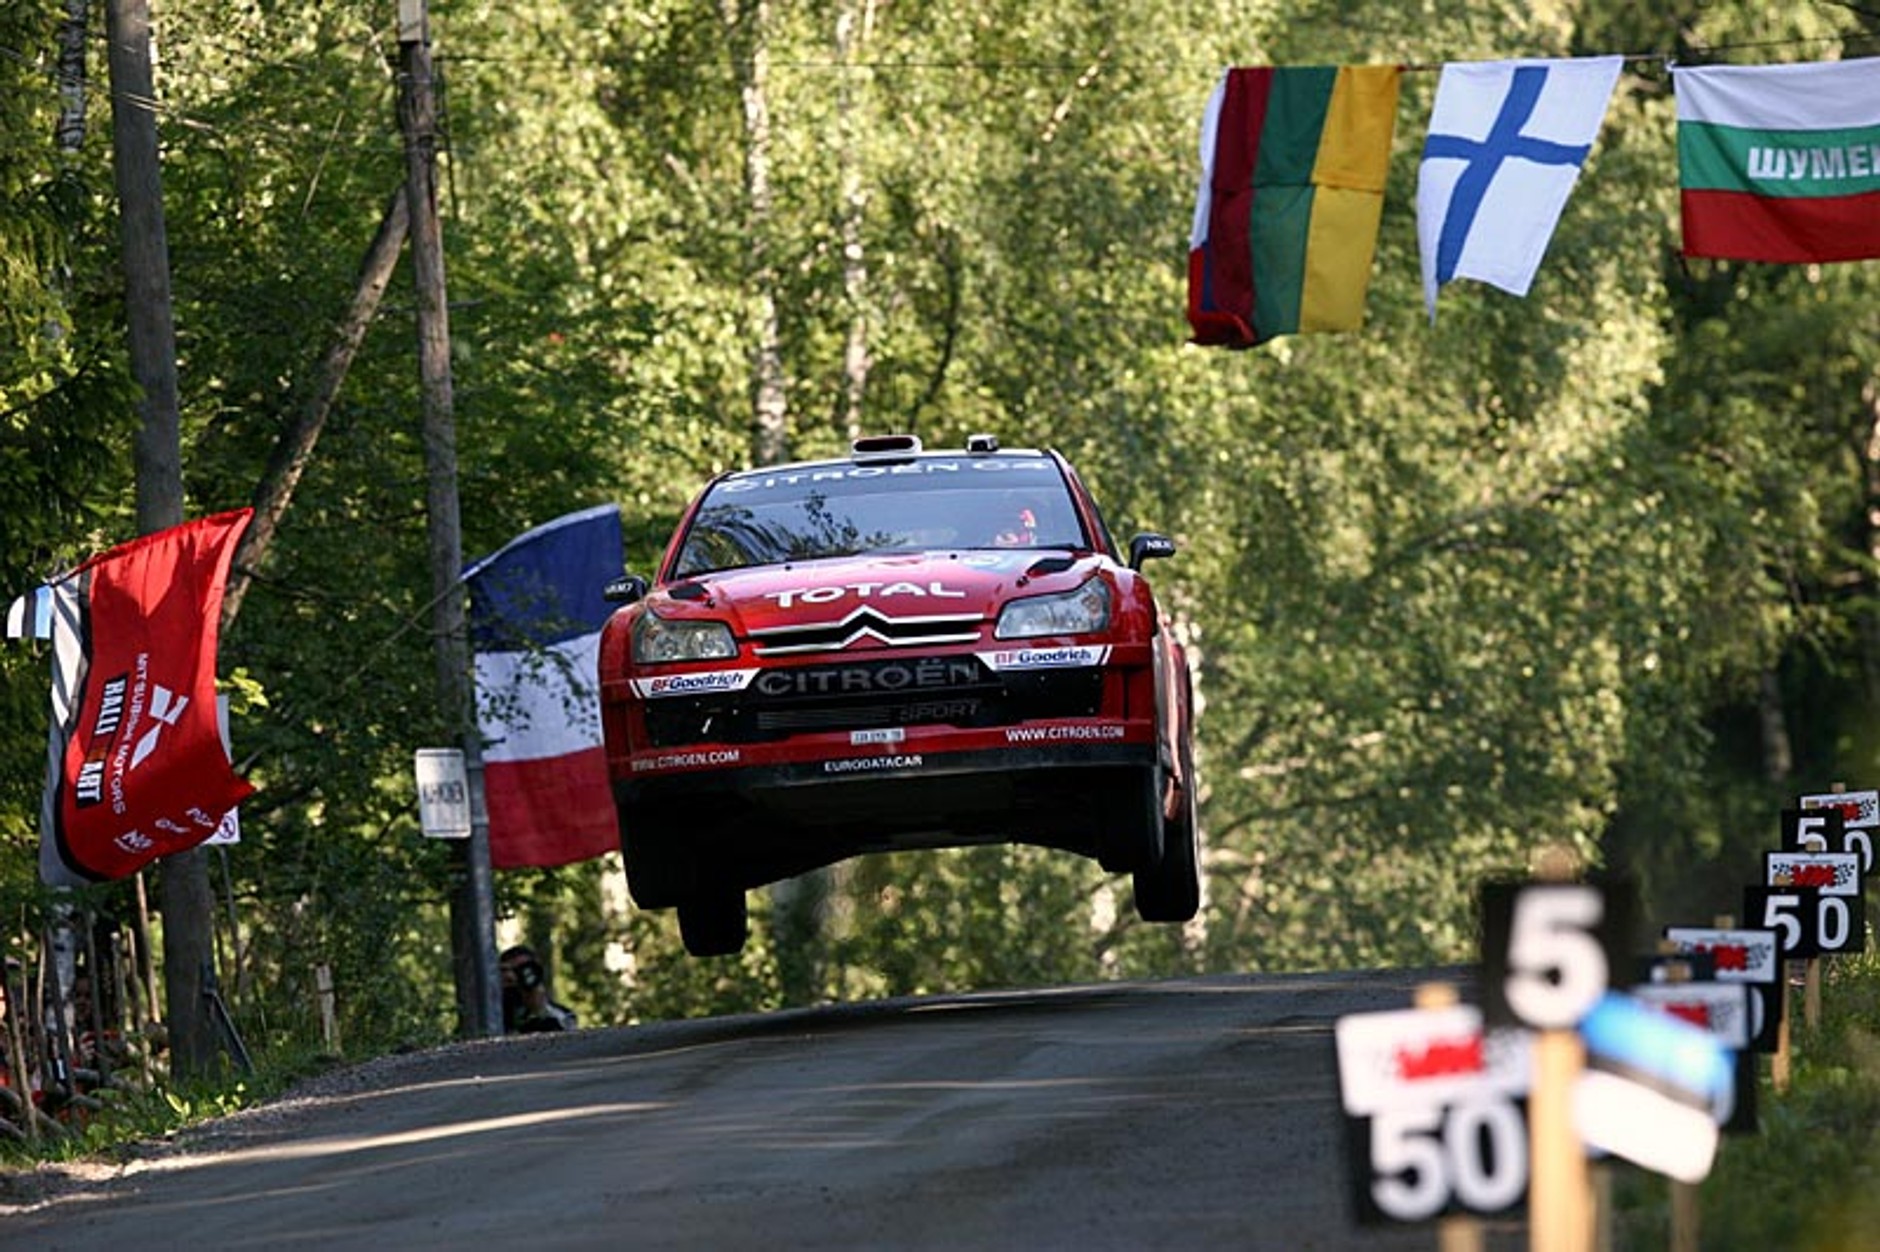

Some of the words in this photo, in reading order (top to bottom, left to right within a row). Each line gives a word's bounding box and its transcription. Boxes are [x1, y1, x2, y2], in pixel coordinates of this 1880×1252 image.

[765, 582, 965, 608] TOTAL
[994, 648, 1092, 664] BFGoodrich
[650, 672, 744, 692] BFGoodrich
[755, 657, 979, 696] CITROËN
[110, 744, 130, 815] MOTORS
[824, 755, 923, 772] EURODATACAR
[1504, 886, 1610, 1029] 5
[1371, 1100, 1530, 1220] 50
